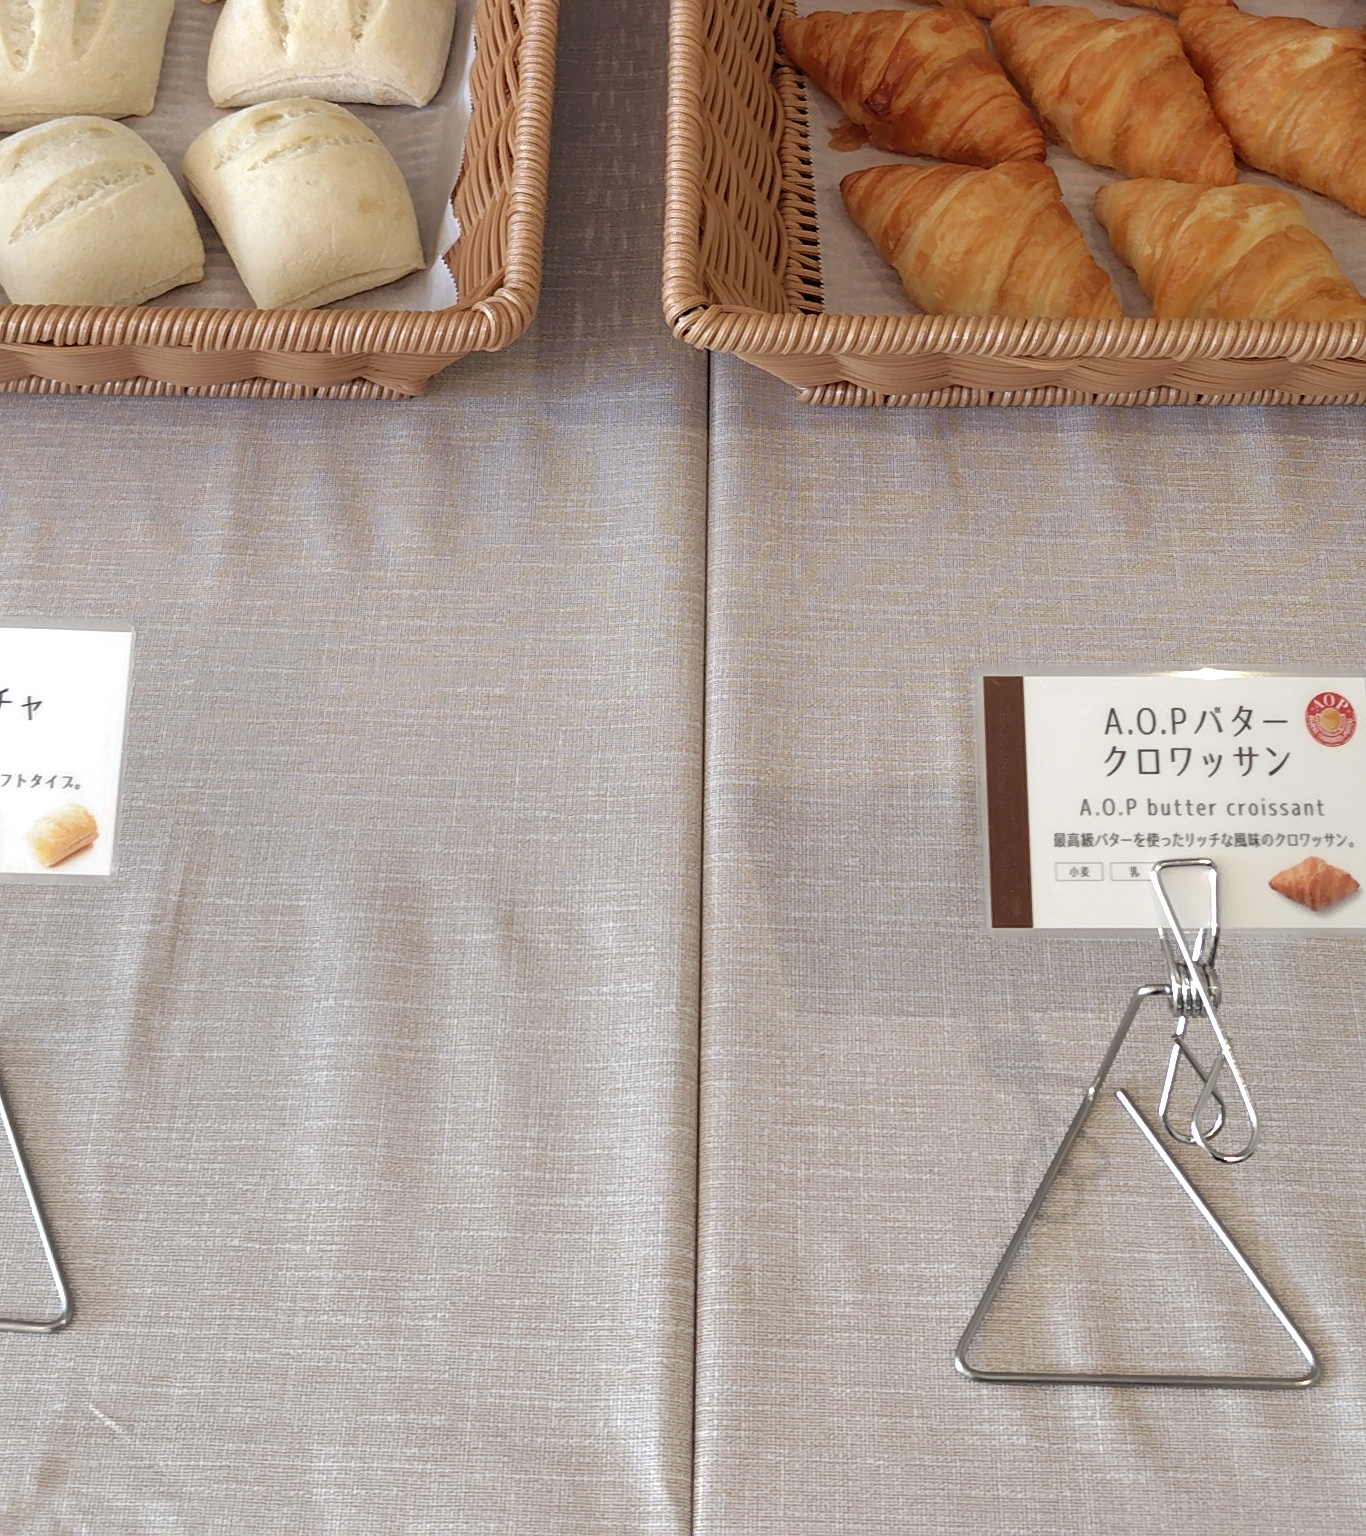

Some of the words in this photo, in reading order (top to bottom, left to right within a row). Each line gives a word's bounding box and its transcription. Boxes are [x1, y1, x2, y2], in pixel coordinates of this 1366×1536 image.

[1311, 693, 1349, 712] AOP
[1105, 706, 1288, 737] A.O.Pバター
[1105, 746, 1290, 777] クロワッサン
[1080, 798, 1136, 816] A.O.P
[1147, 798, 1216, 816] butter
[1227, 798, 1324, 816] croissant
[1054, 833, 1354, 848] 最高級バターを使ったリッチな風味のクロワッサン。
[1069, 867, 1089, 877] 小麦
